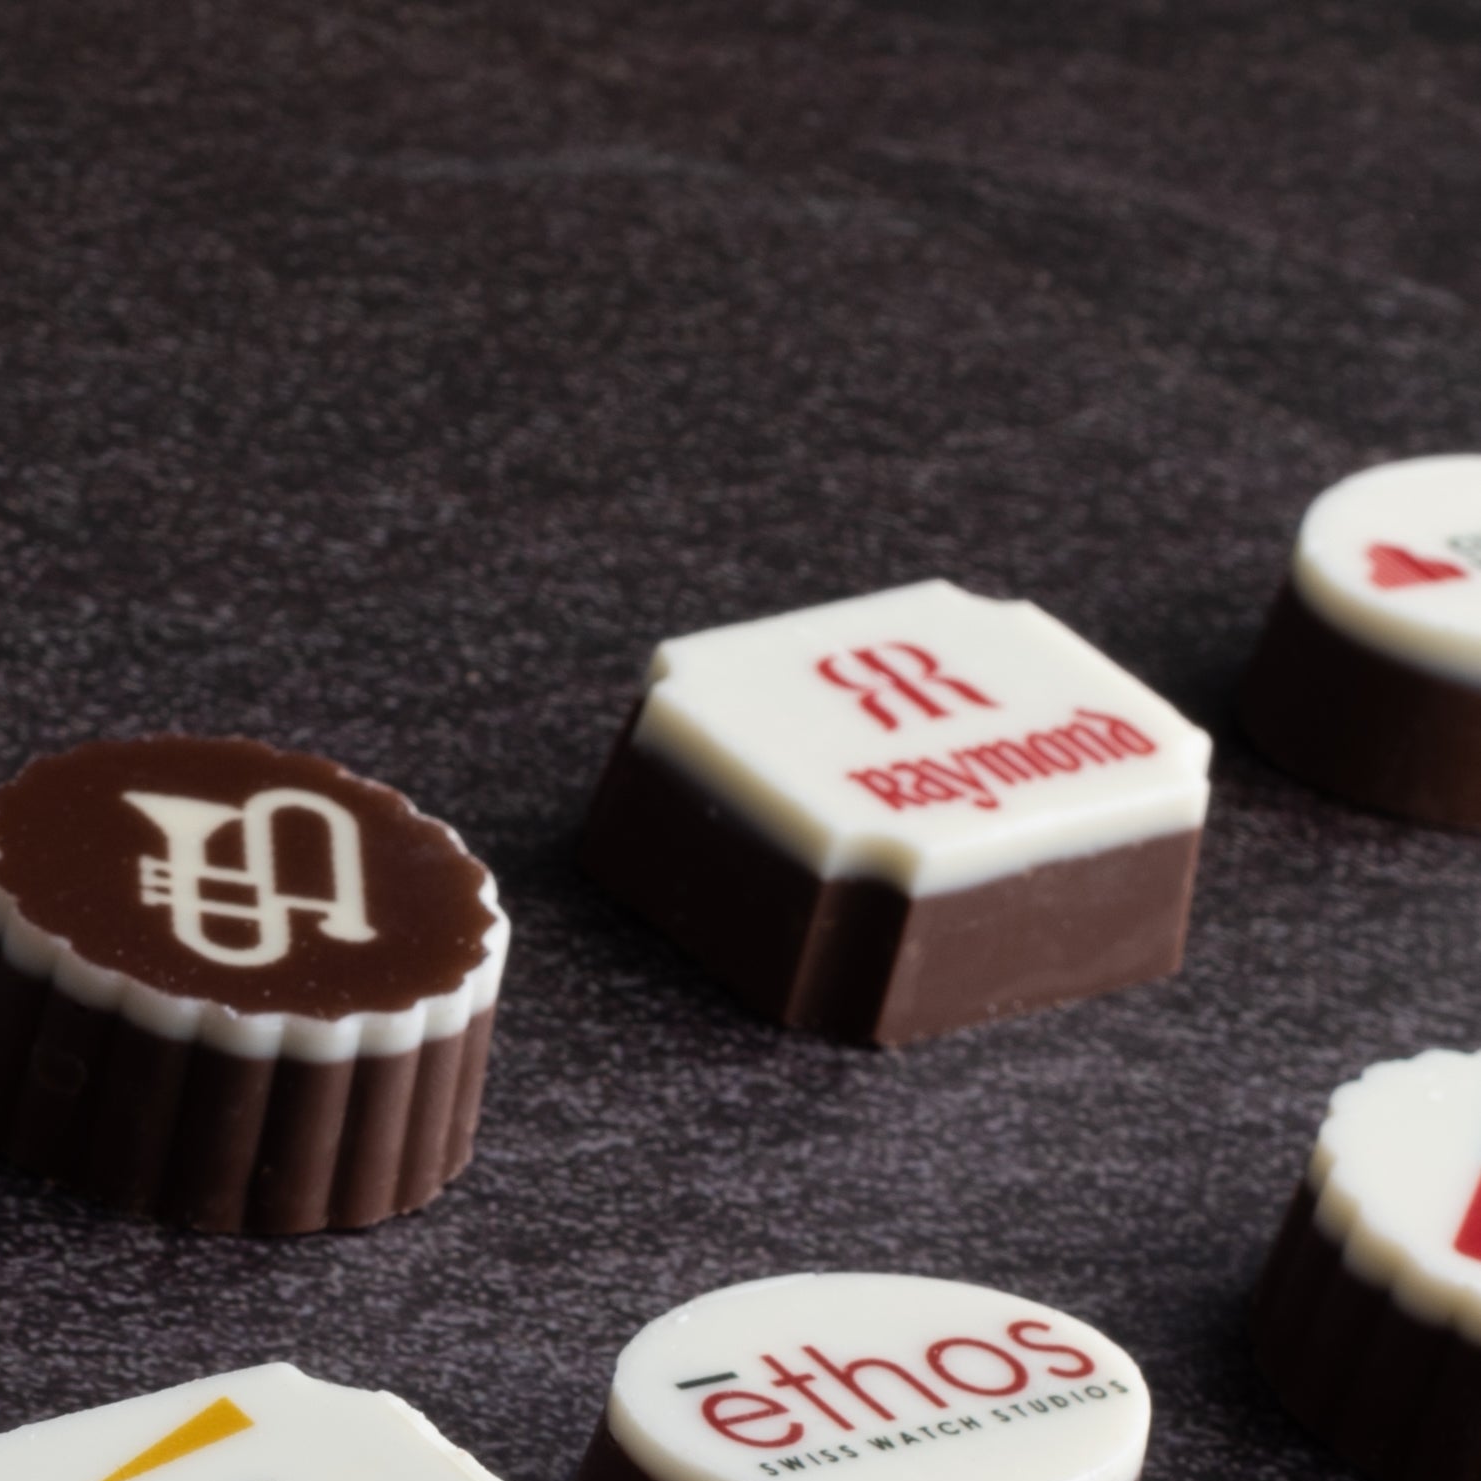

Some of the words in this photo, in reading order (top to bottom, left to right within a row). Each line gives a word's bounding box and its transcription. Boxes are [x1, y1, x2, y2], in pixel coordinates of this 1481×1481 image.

[759, 1444, 860, 1477] SWISS
[867, 1416, 982, 1452] WATCH
[990, 1379, 1130, 1424] STUDIOS
